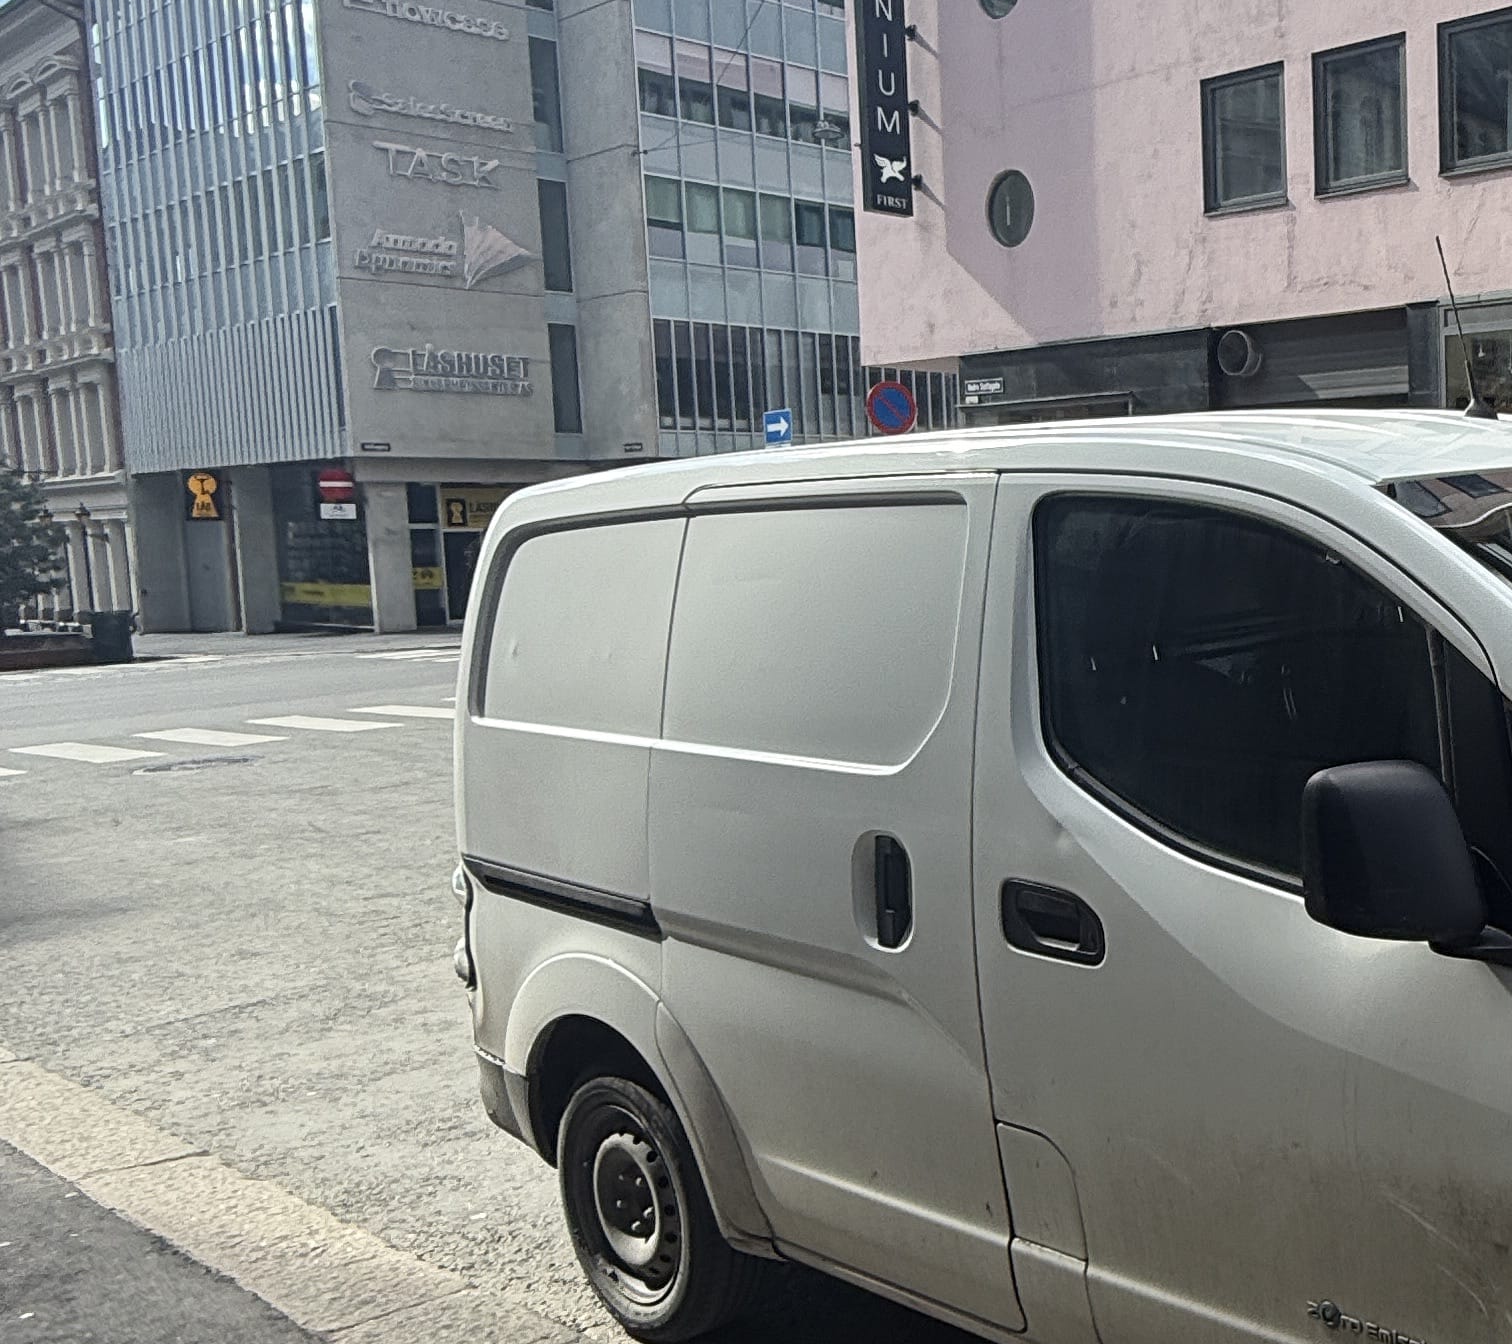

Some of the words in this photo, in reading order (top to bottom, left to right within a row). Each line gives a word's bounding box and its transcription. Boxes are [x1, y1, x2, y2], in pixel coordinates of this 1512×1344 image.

[372, 140, 500, 189] TASK
[876, 193, 907, 209] FIRST
[410, 343, 529, 379] LÅSHUSET
